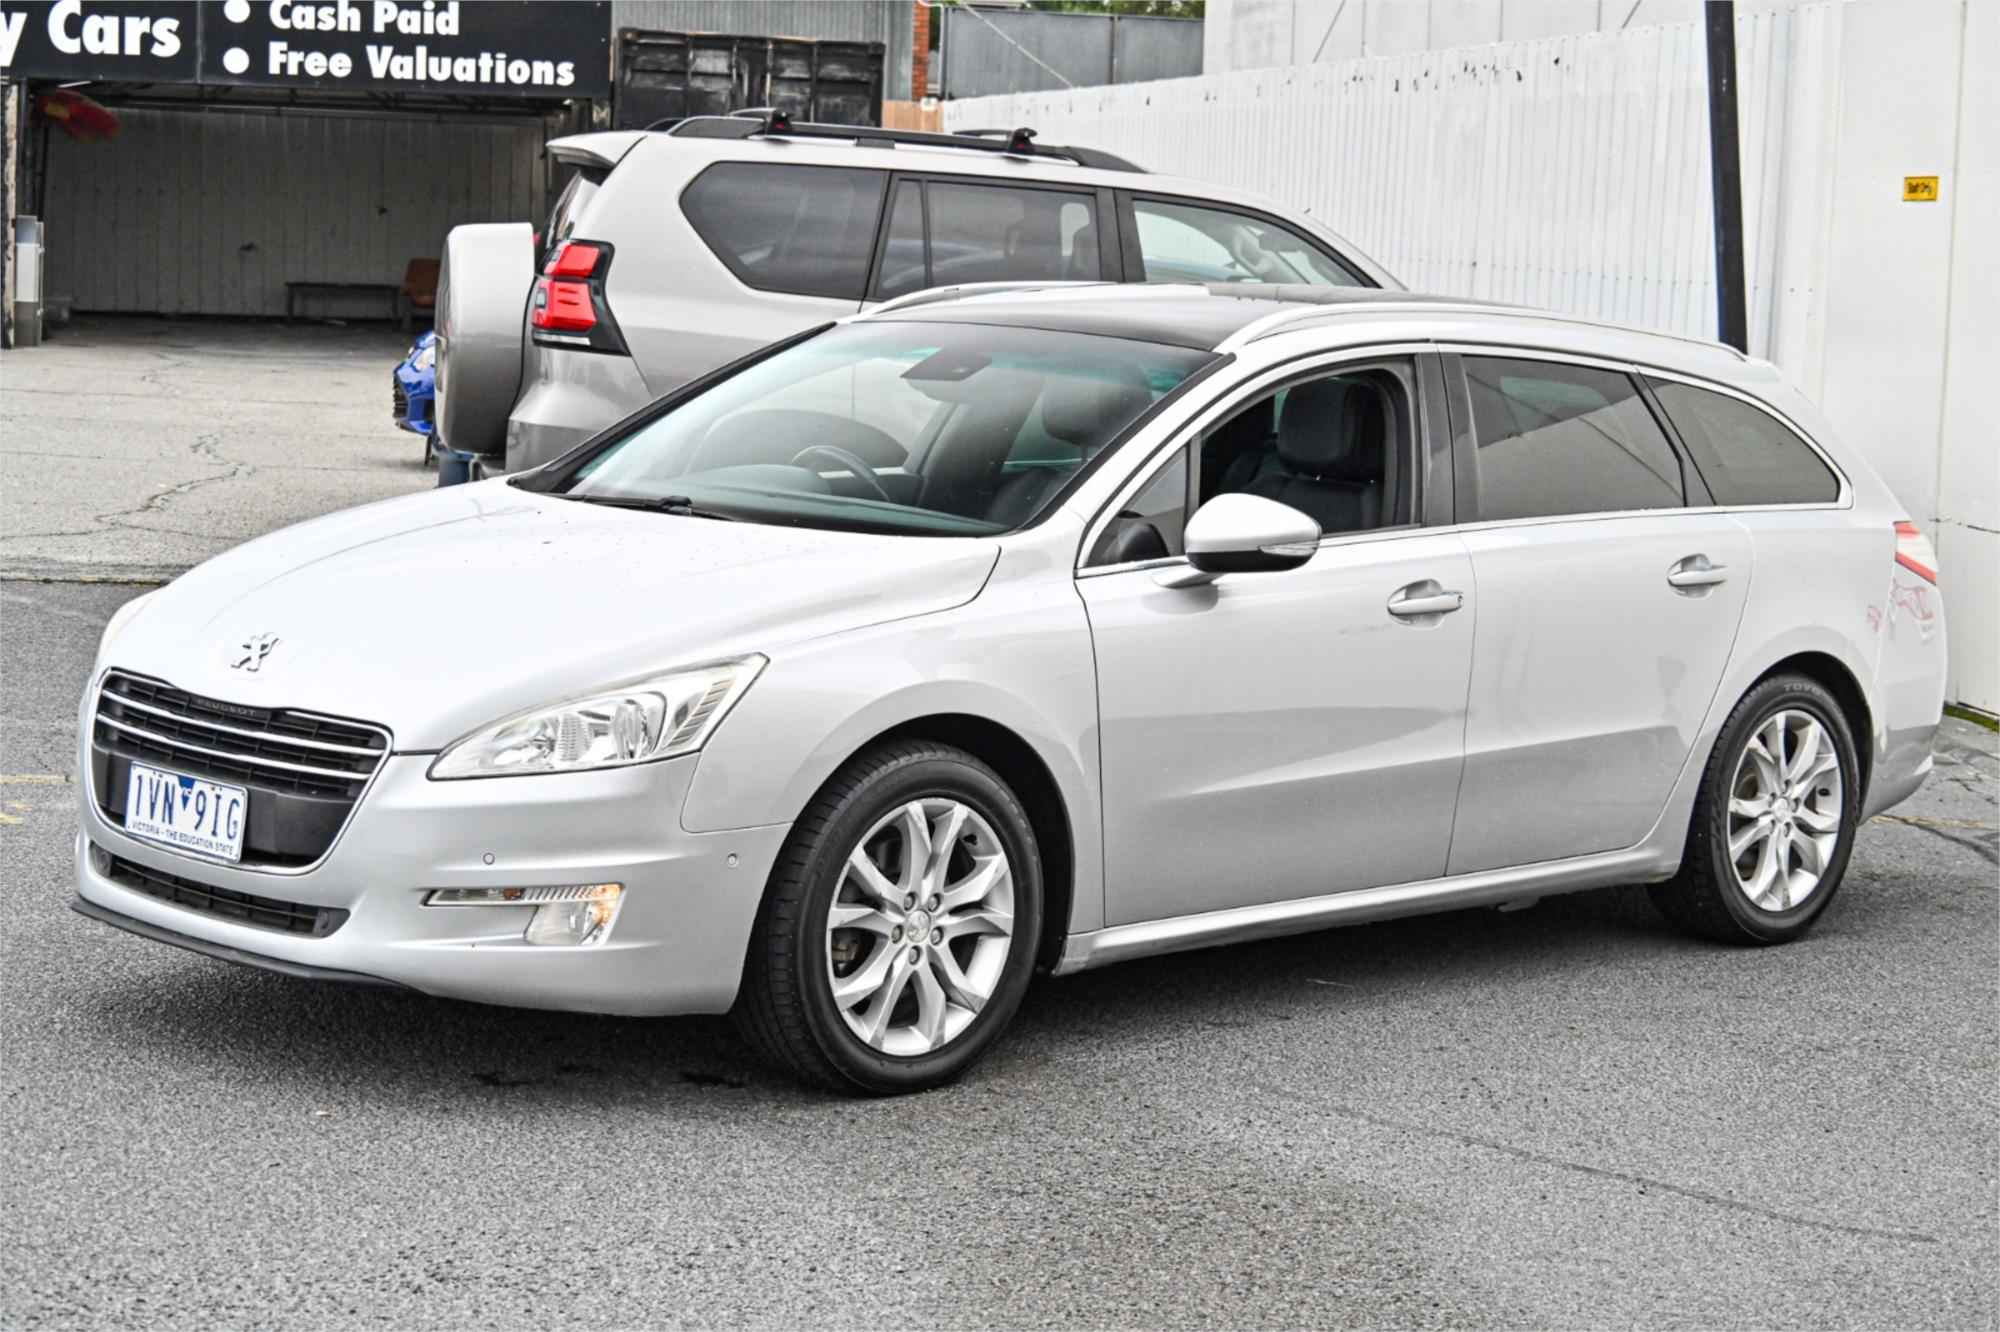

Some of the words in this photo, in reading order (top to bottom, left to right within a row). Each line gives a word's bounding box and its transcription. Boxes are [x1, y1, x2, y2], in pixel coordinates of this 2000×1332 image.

[47, 0, 181, 57] Cars
[269, 0, 361, 32] Cash
[373, 0, 459, 35] Paid
[268, 41, 352, 77] Free
[366, 45, 575, 86] Valuations
[1784, 682, 1821, 696] TOYO
[136, 774, 175, 825] 1VN
[132, 820, 160, 835] VICTORIA
[166, 829, 178, 841] THE
[179, 832, 213, 849] EDUCATION
[215, 842, 234, 855] STATE
